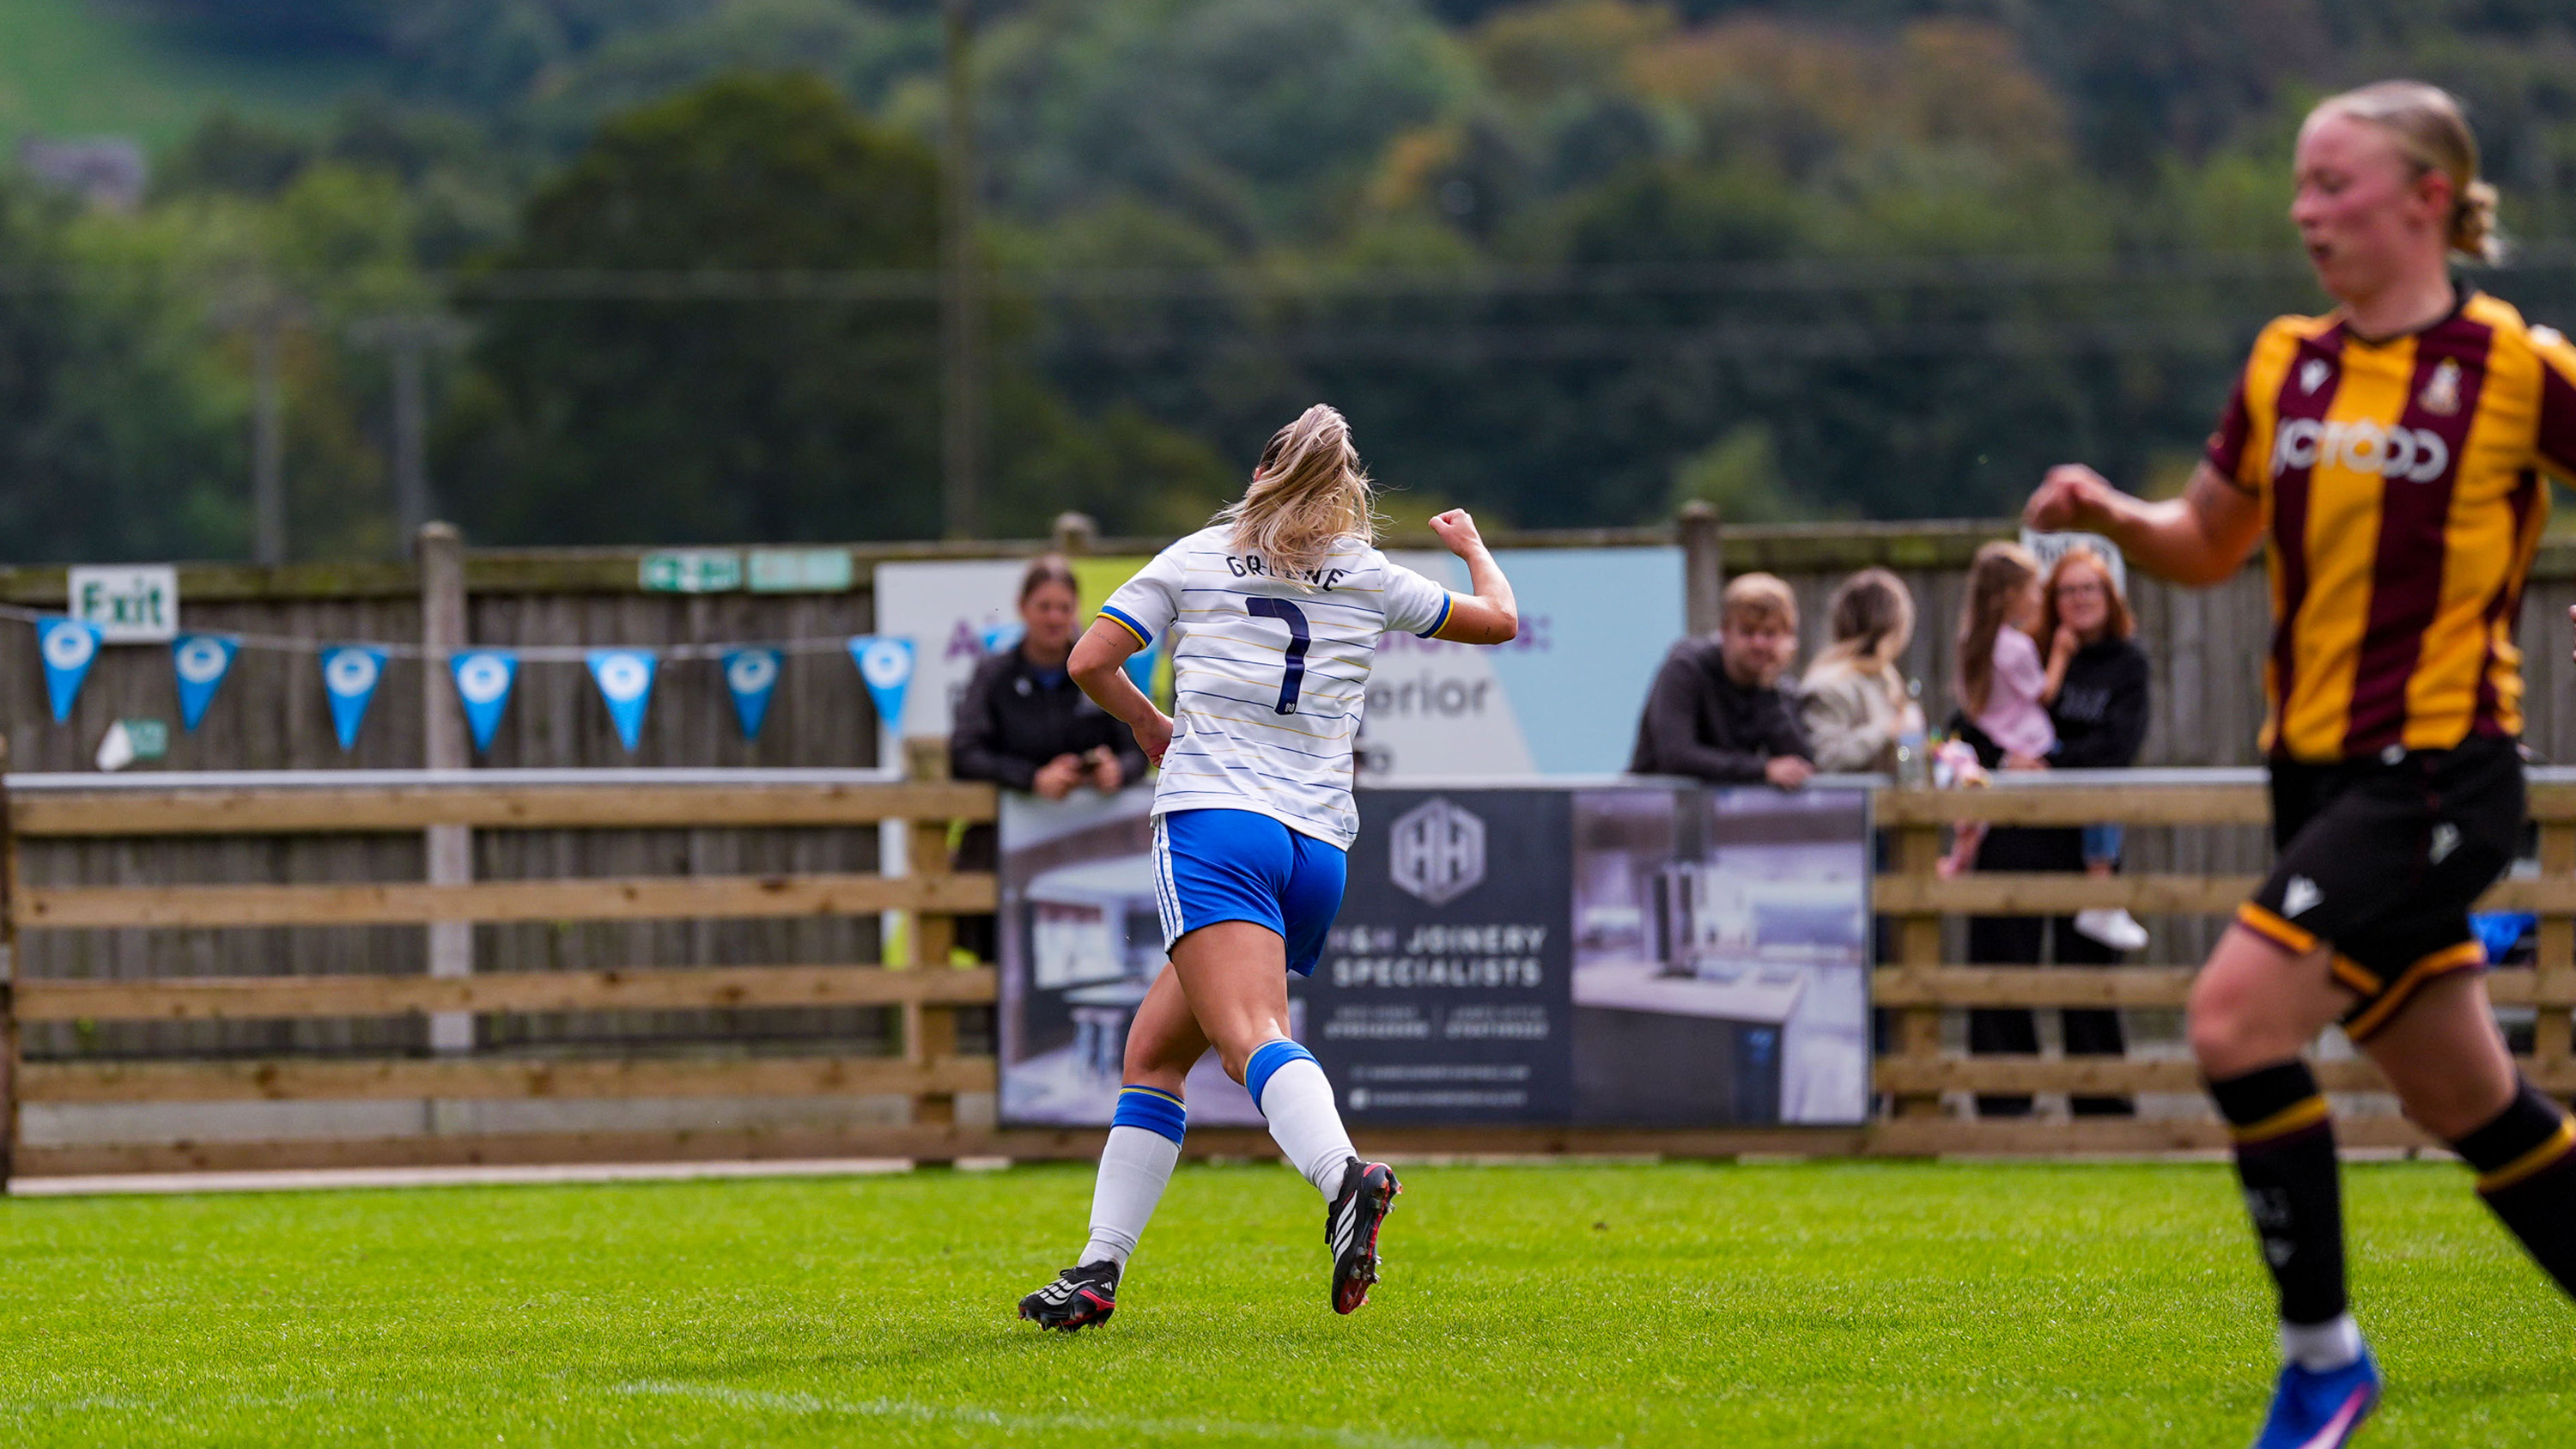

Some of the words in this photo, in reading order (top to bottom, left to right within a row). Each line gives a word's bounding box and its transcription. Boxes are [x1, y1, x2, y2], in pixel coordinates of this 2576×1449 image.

[1226, 555, 1344, 591] GRNE
[82, 577, 163, 627] Exit
[1244, 596, 1311, 715] 7
[1367, 669, 1494, 718] erior
[1406, 924, 1546, 955] JOINERY
[1333, 957, 1543, 988] SPECIALISTS
